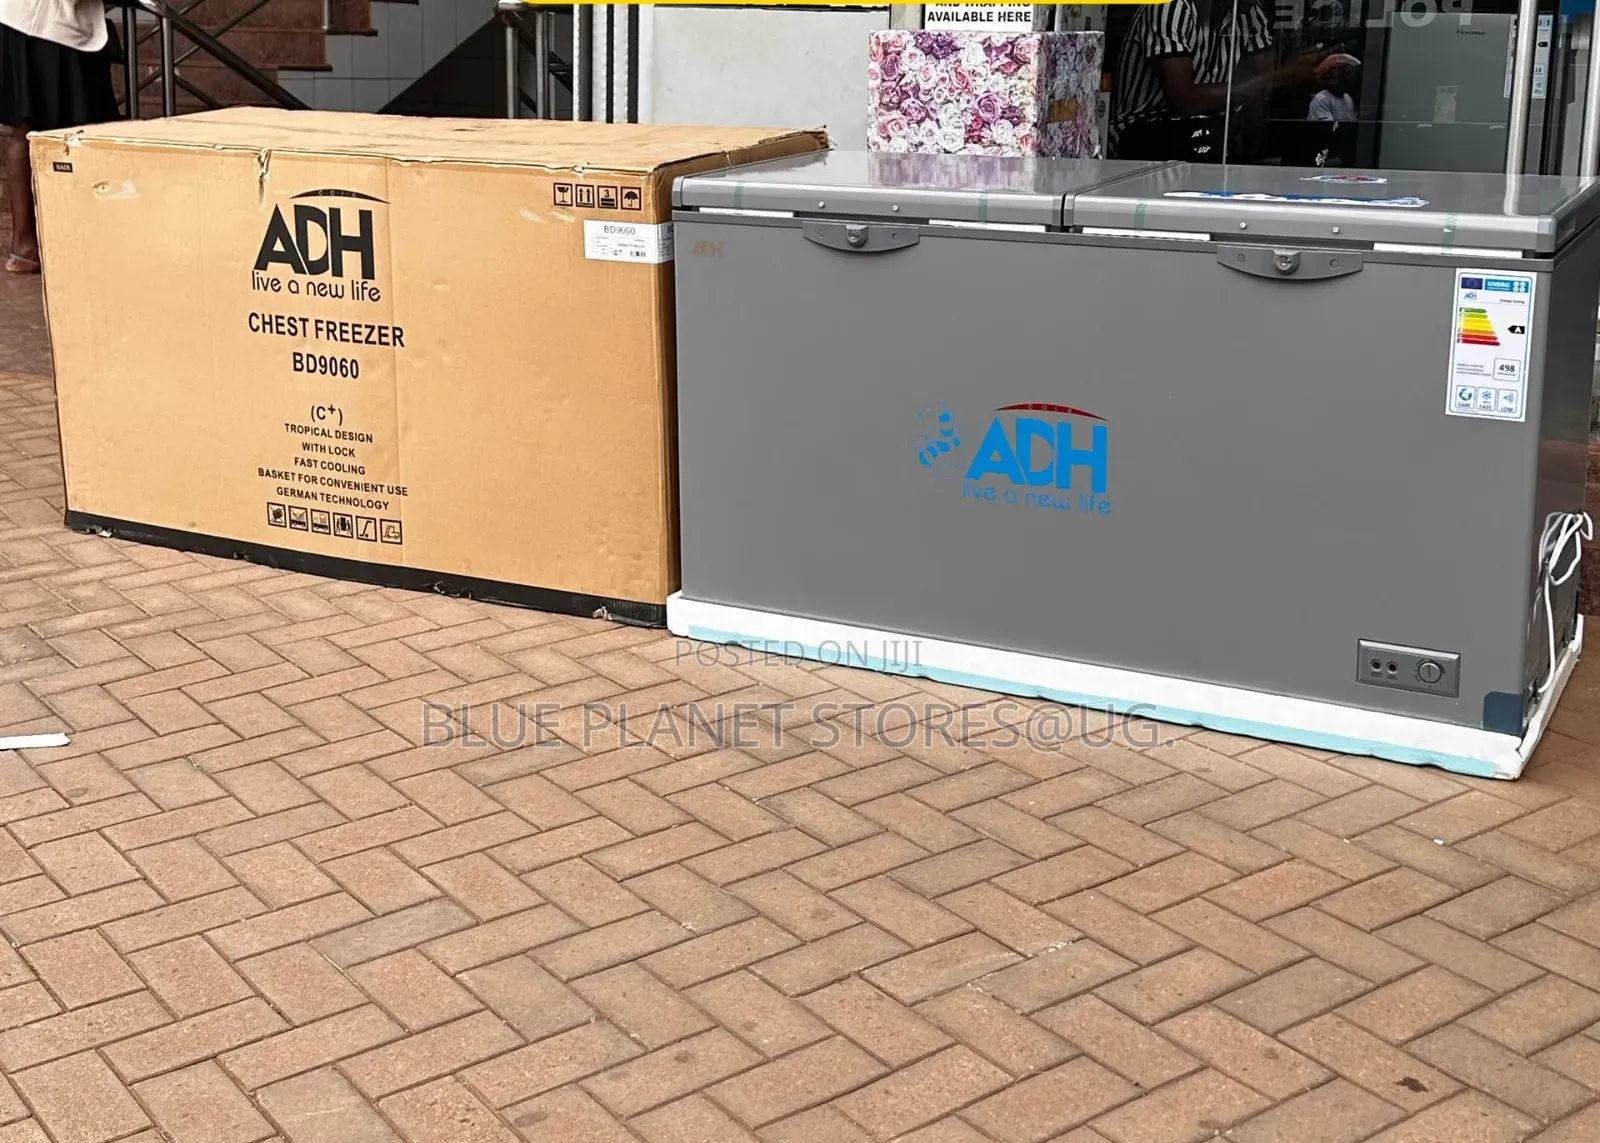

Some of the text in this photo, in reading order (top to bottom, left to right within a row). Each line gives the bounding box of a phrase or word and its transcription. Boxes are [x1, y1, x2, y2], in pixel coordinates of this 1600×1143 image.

[928, 11, 1032, 22] AVAILABLE HERE
[604, 189, 610, 198] 3
[253, 203, 375, 280] ADH
[604, 225, 636, 236] BD9060
[252, 270, 381, 302] live a new life
[248, 312, 406, 348] CHEST FREEZER
[292, 352, 360, 379] BD9060
[1499, 364, 1516, 373] 498
[284, 423, 373, 443] TROPICAL DESIGN
[302, 442, 356, 458] WITH LOCK
[965, 416, 1108, 494] ADH
[294, 457, 366, 475] FAST COOLING
[258, 467, 409, 497] BASKET FOR CONVENIENT USE
[276, 486, 390, 511] GERMAN TECHNOLOGY
[962, 480, 1111, 515] live a new life
